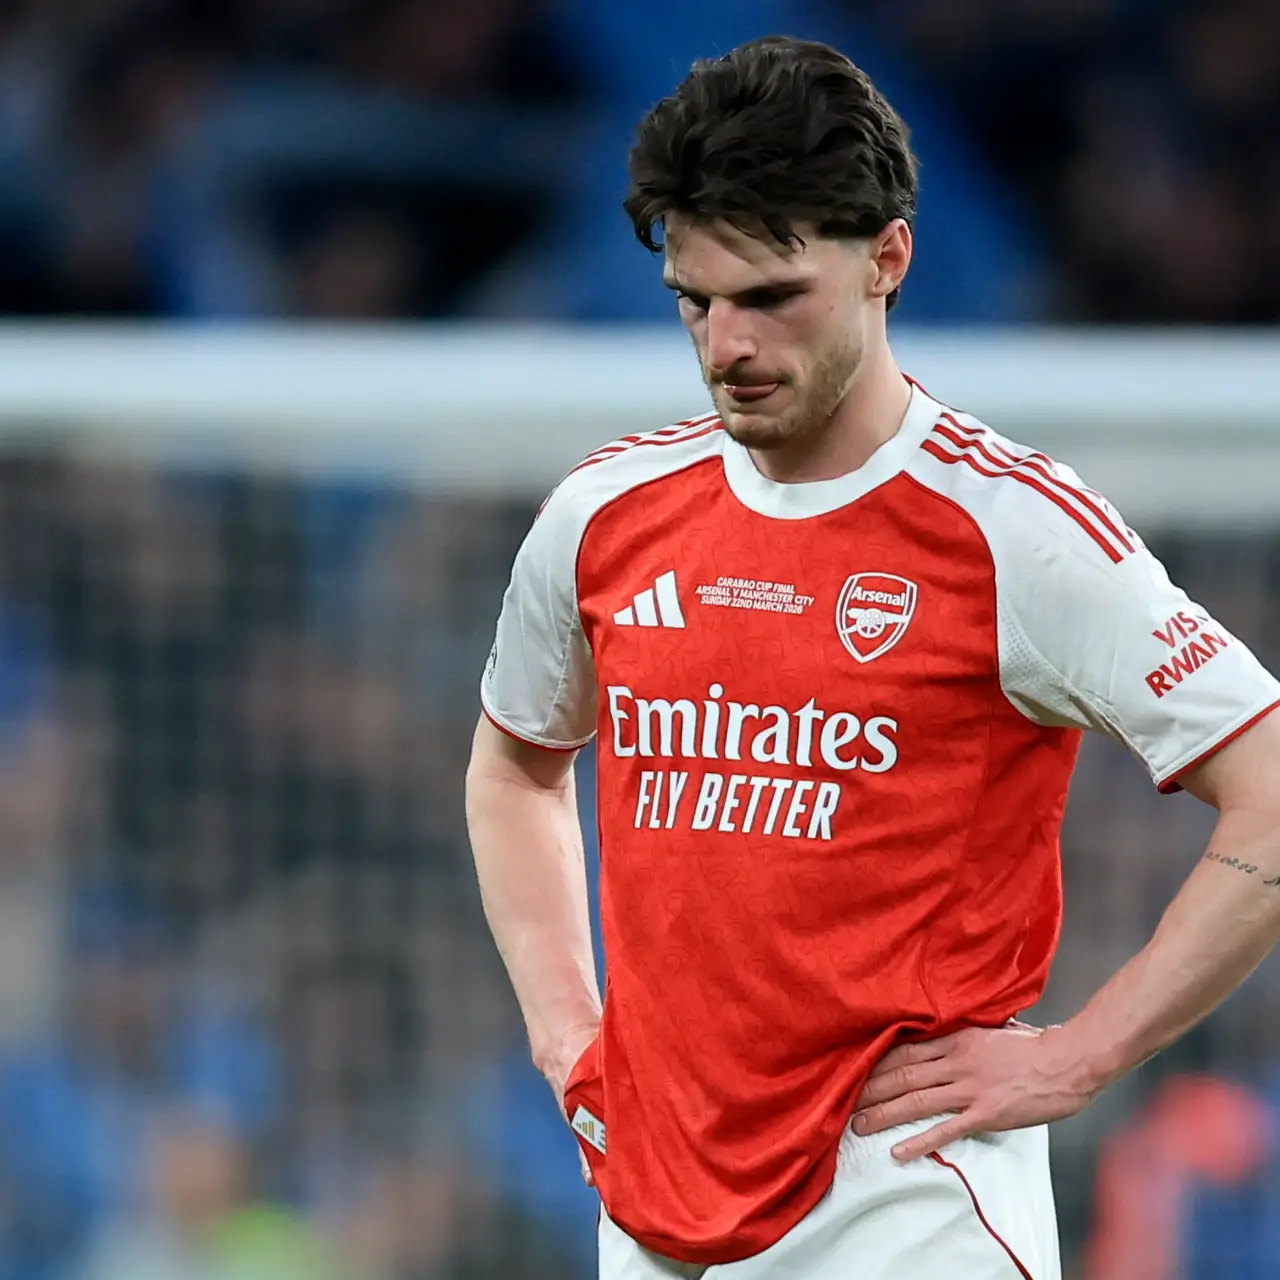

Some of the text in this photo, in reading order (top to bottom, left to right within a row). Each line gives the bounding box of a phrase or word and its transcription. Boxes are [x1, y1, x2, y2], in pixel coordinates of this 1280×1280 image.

[695, 585, 732, 597] ARSENAL
[740, 588, 793, 603] MANCHESTER
[794, 594, 815, 606] CITY
[717, 577, 796, 595] CARABAO CUP FINAL
[851, 586, 906, 607] Arsenal
[700, 595, 804, 614] SUNDAY 22ND MARCH 2026
[1144, 630, 1236, 699] RWAN
[606, 683, 899, 774] Emirates
[634, 771, 841, 840] FLY BETTER
